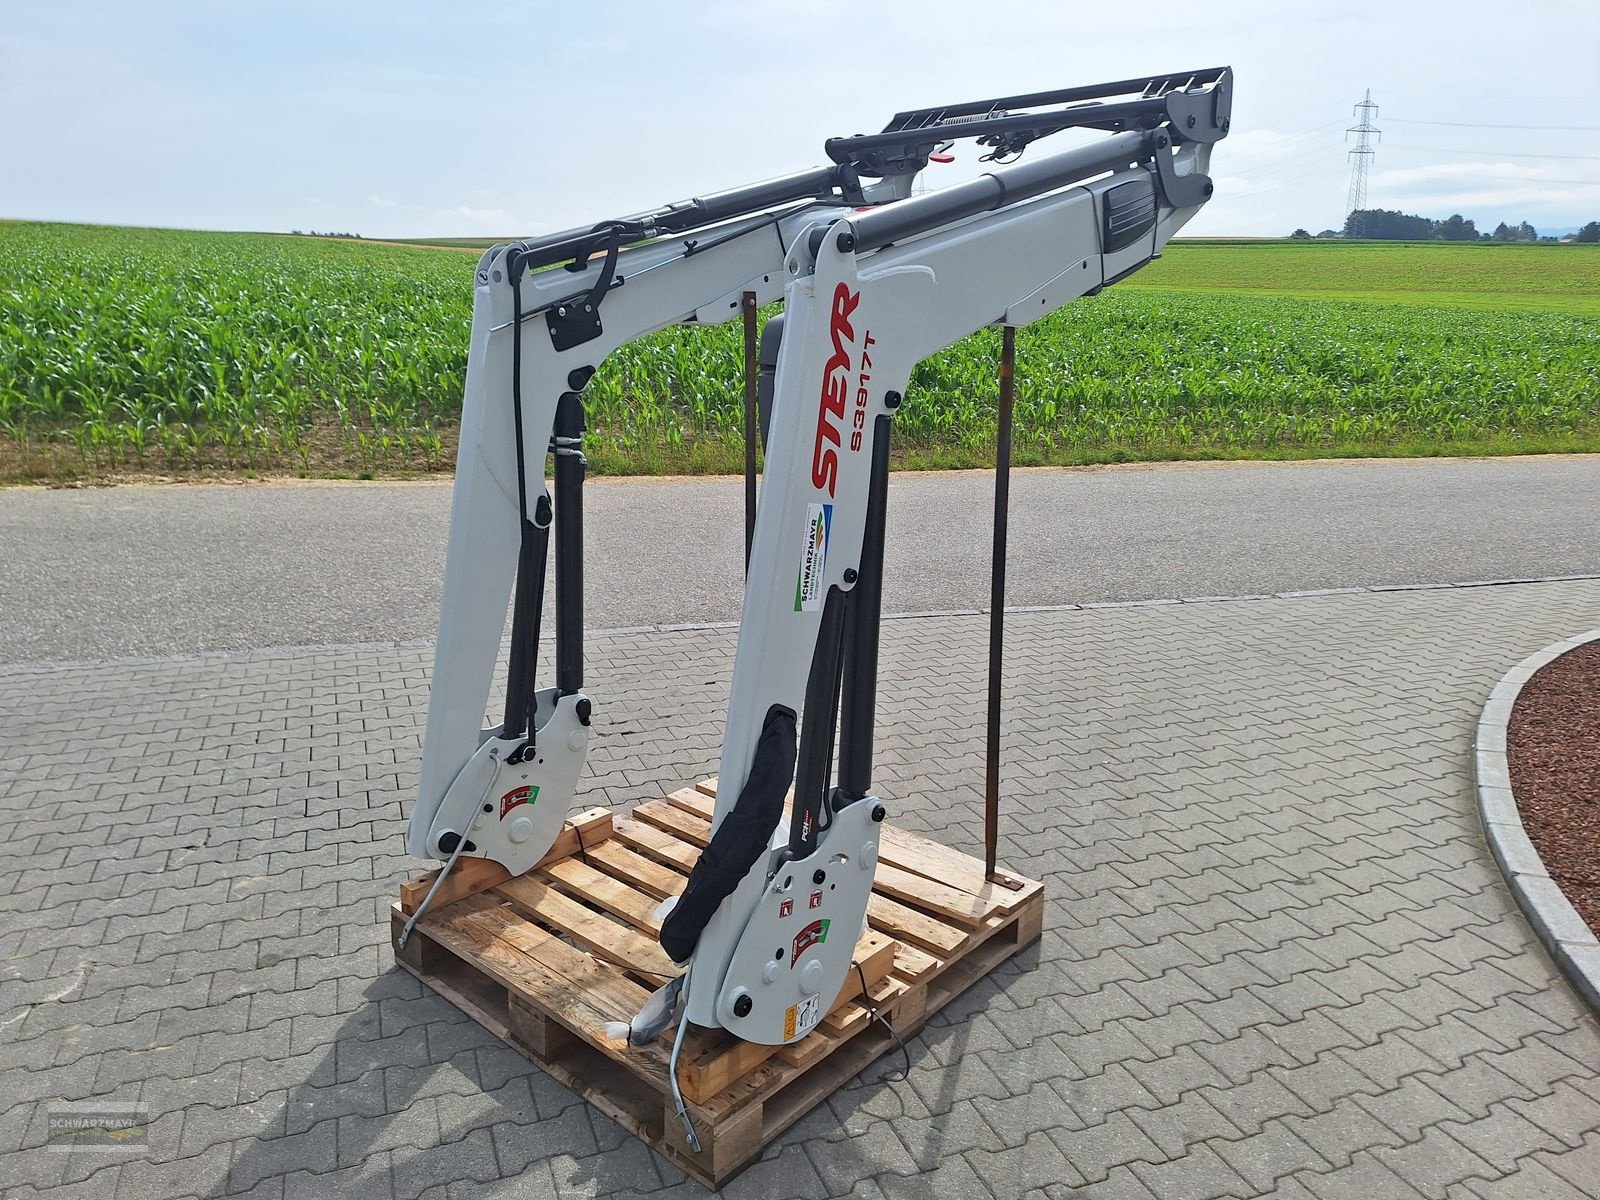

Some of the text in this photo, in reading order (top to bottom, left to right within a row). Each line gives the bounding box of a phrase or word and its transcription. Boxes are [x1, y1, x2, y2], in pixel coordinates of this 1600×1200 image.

[812, 282, 860, 499] STEYR
[850, 330, 876, 452] S3917T
[801, 518, 817, 602] SCHWARZMAYR
[808, 552, 818, 601] LANDTECHNIK
